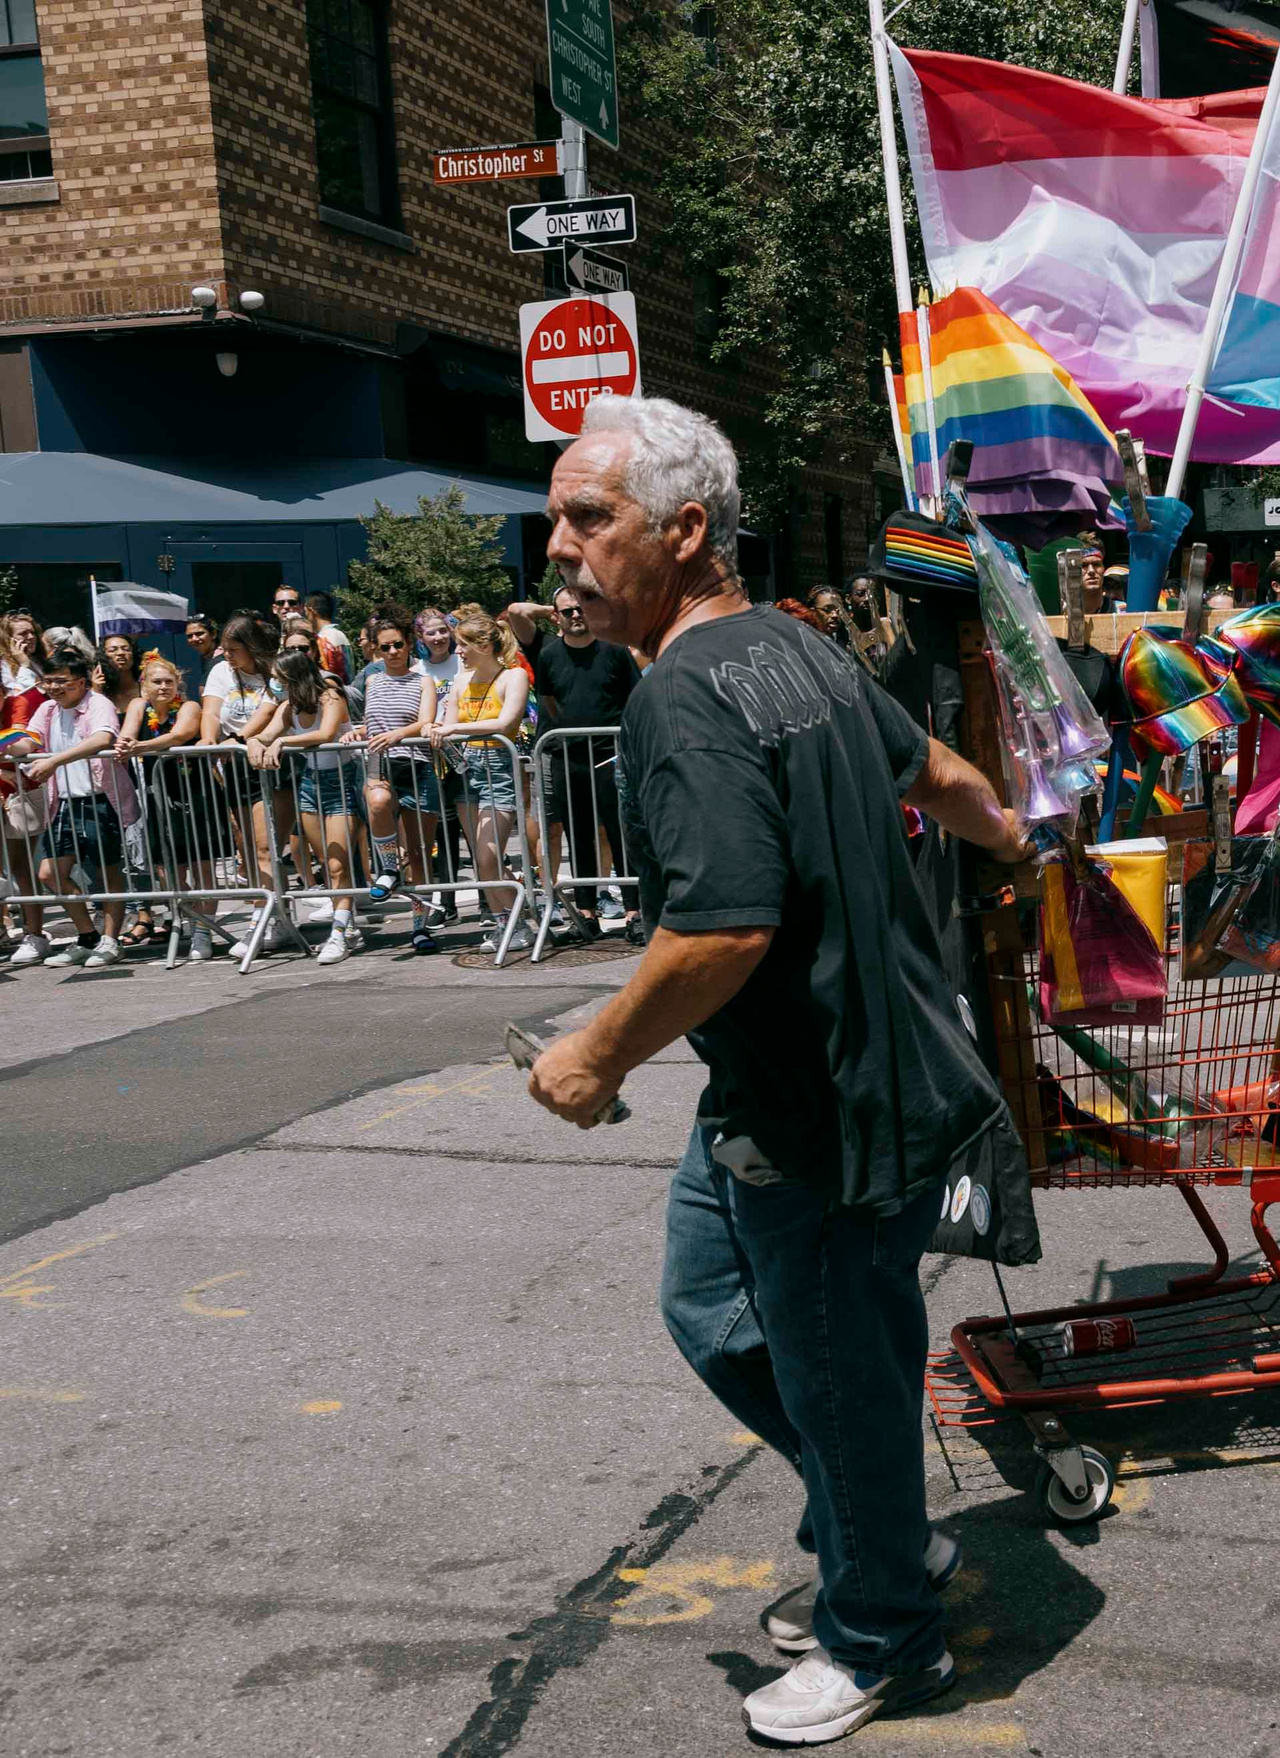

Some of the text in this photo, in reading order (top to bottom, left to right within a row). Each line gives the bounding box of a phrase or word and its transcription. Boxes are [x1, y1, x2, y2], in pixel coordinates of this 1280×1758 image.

[581, 13, 605, 49] SOUTH
[552, 29, 613, 93] CHRISTOPHER ST
[561, 72, 581, 106] WEST
[439, 153, 527, 179] Christopher
[533, 149, 544, 163] St
[547, 211, 619, 234] ONE WAY
[583, 262, 621, 290] ONE WAY
[540, 323, 617, 352] DO NOT
